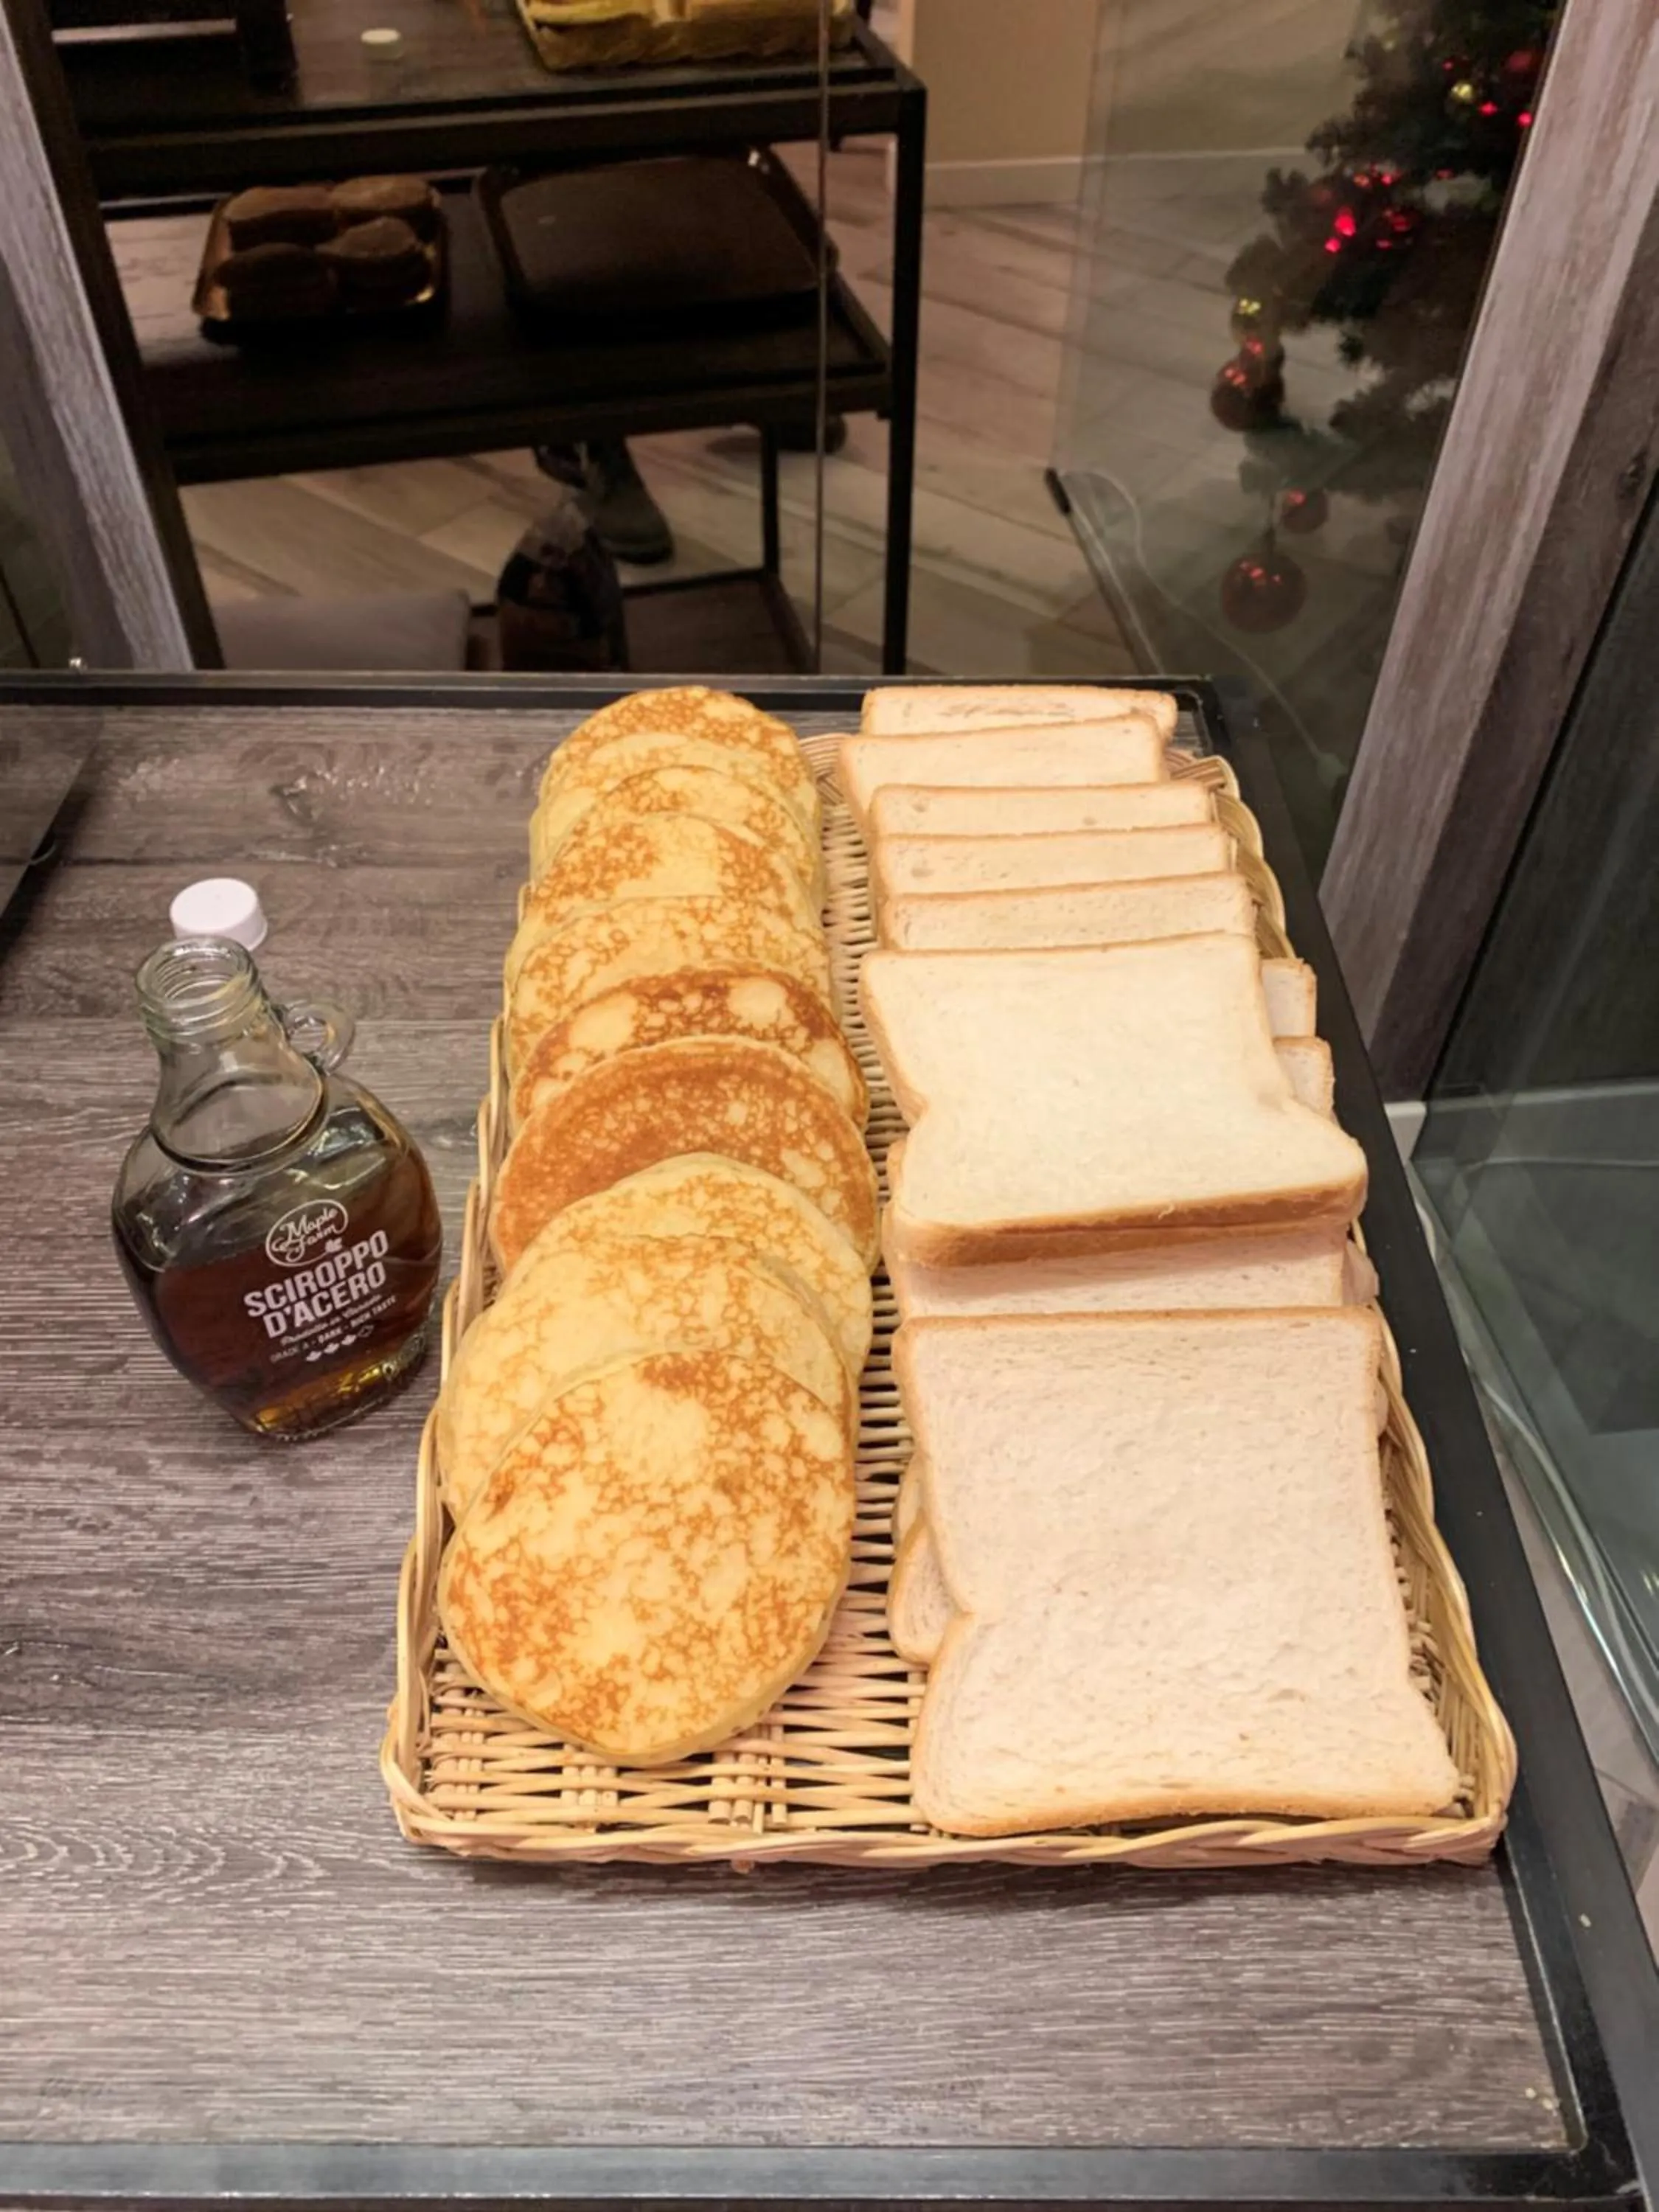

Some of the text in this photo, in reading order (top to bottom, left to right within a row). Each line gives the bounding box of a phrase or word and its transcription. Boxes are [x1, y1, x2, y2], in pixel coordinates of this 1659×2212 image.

[276, 1207, 338, 1248] Maple
[285, 1224, 339, 1262] Farm
[243, 1229, 389, 1317] SCIROPPO
[262, 1262, 386, 1338] D'ACERO
